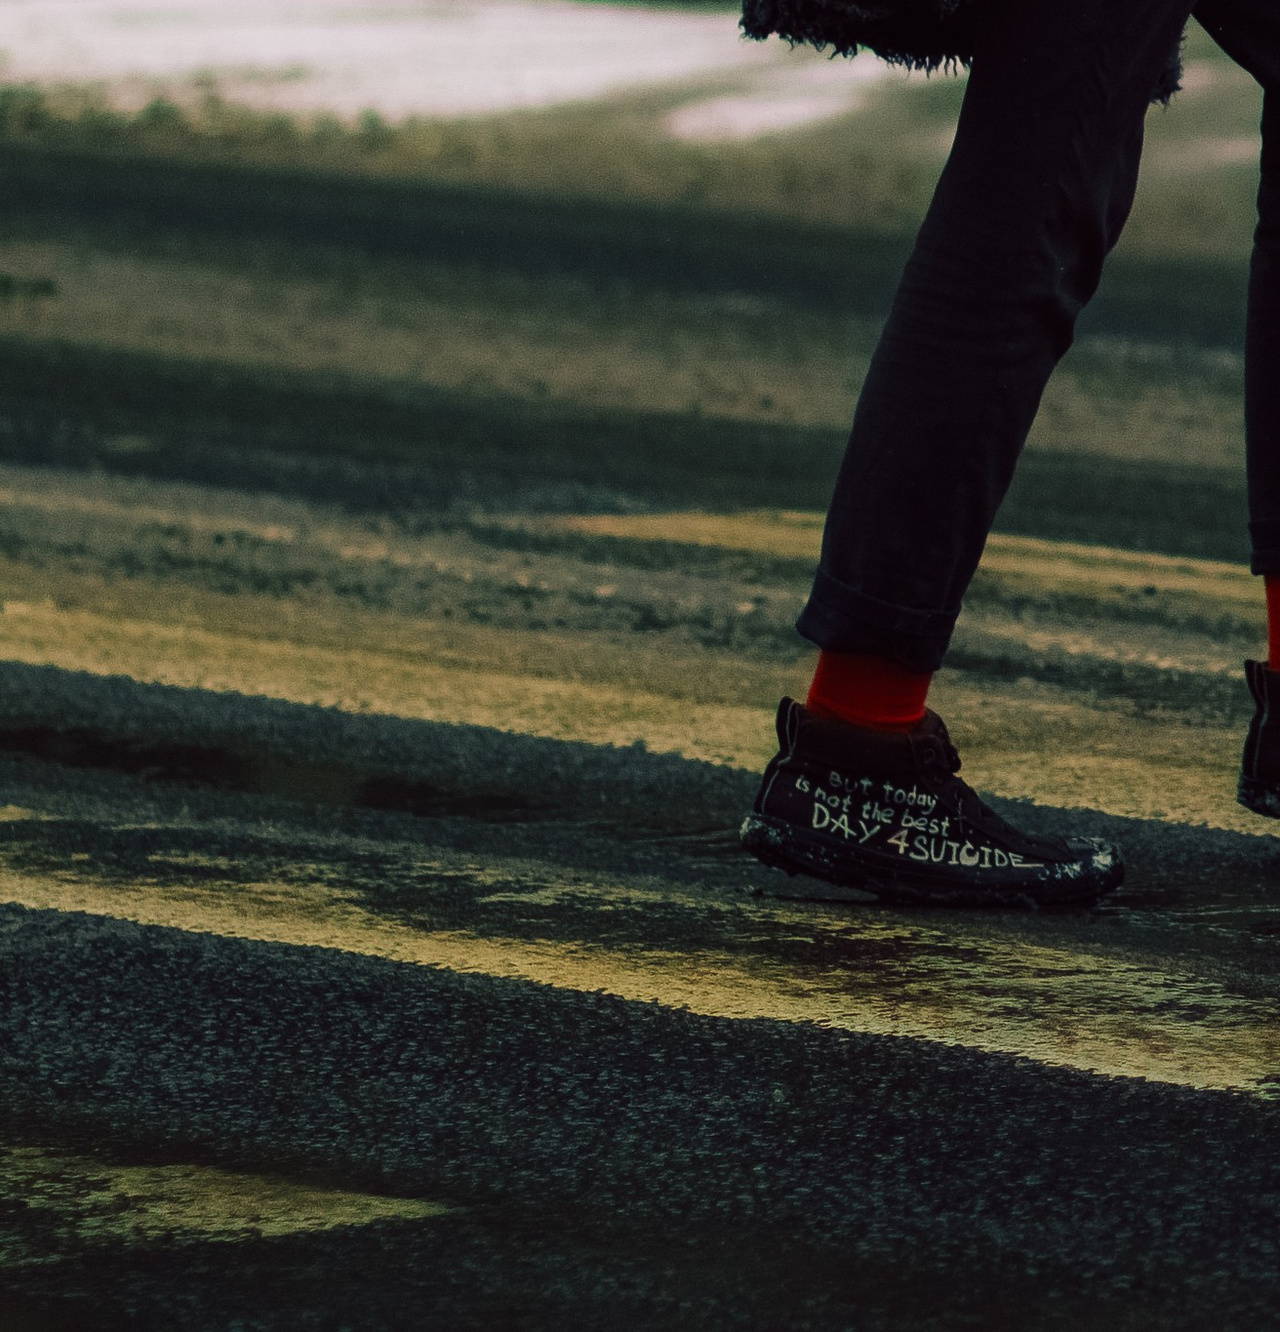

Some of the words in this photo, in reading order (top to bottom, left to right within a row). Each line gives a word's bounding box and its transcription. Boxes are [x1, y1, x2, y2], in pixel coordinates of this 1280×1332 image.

[795, 774, 810, 792] is
[814, 787, 852, 812] not
[862, 802, 894, 824] the
[900, 808, 950, 838] best
[883, 780, 939, 815] today
[812, 802, 881, 844] DAY
